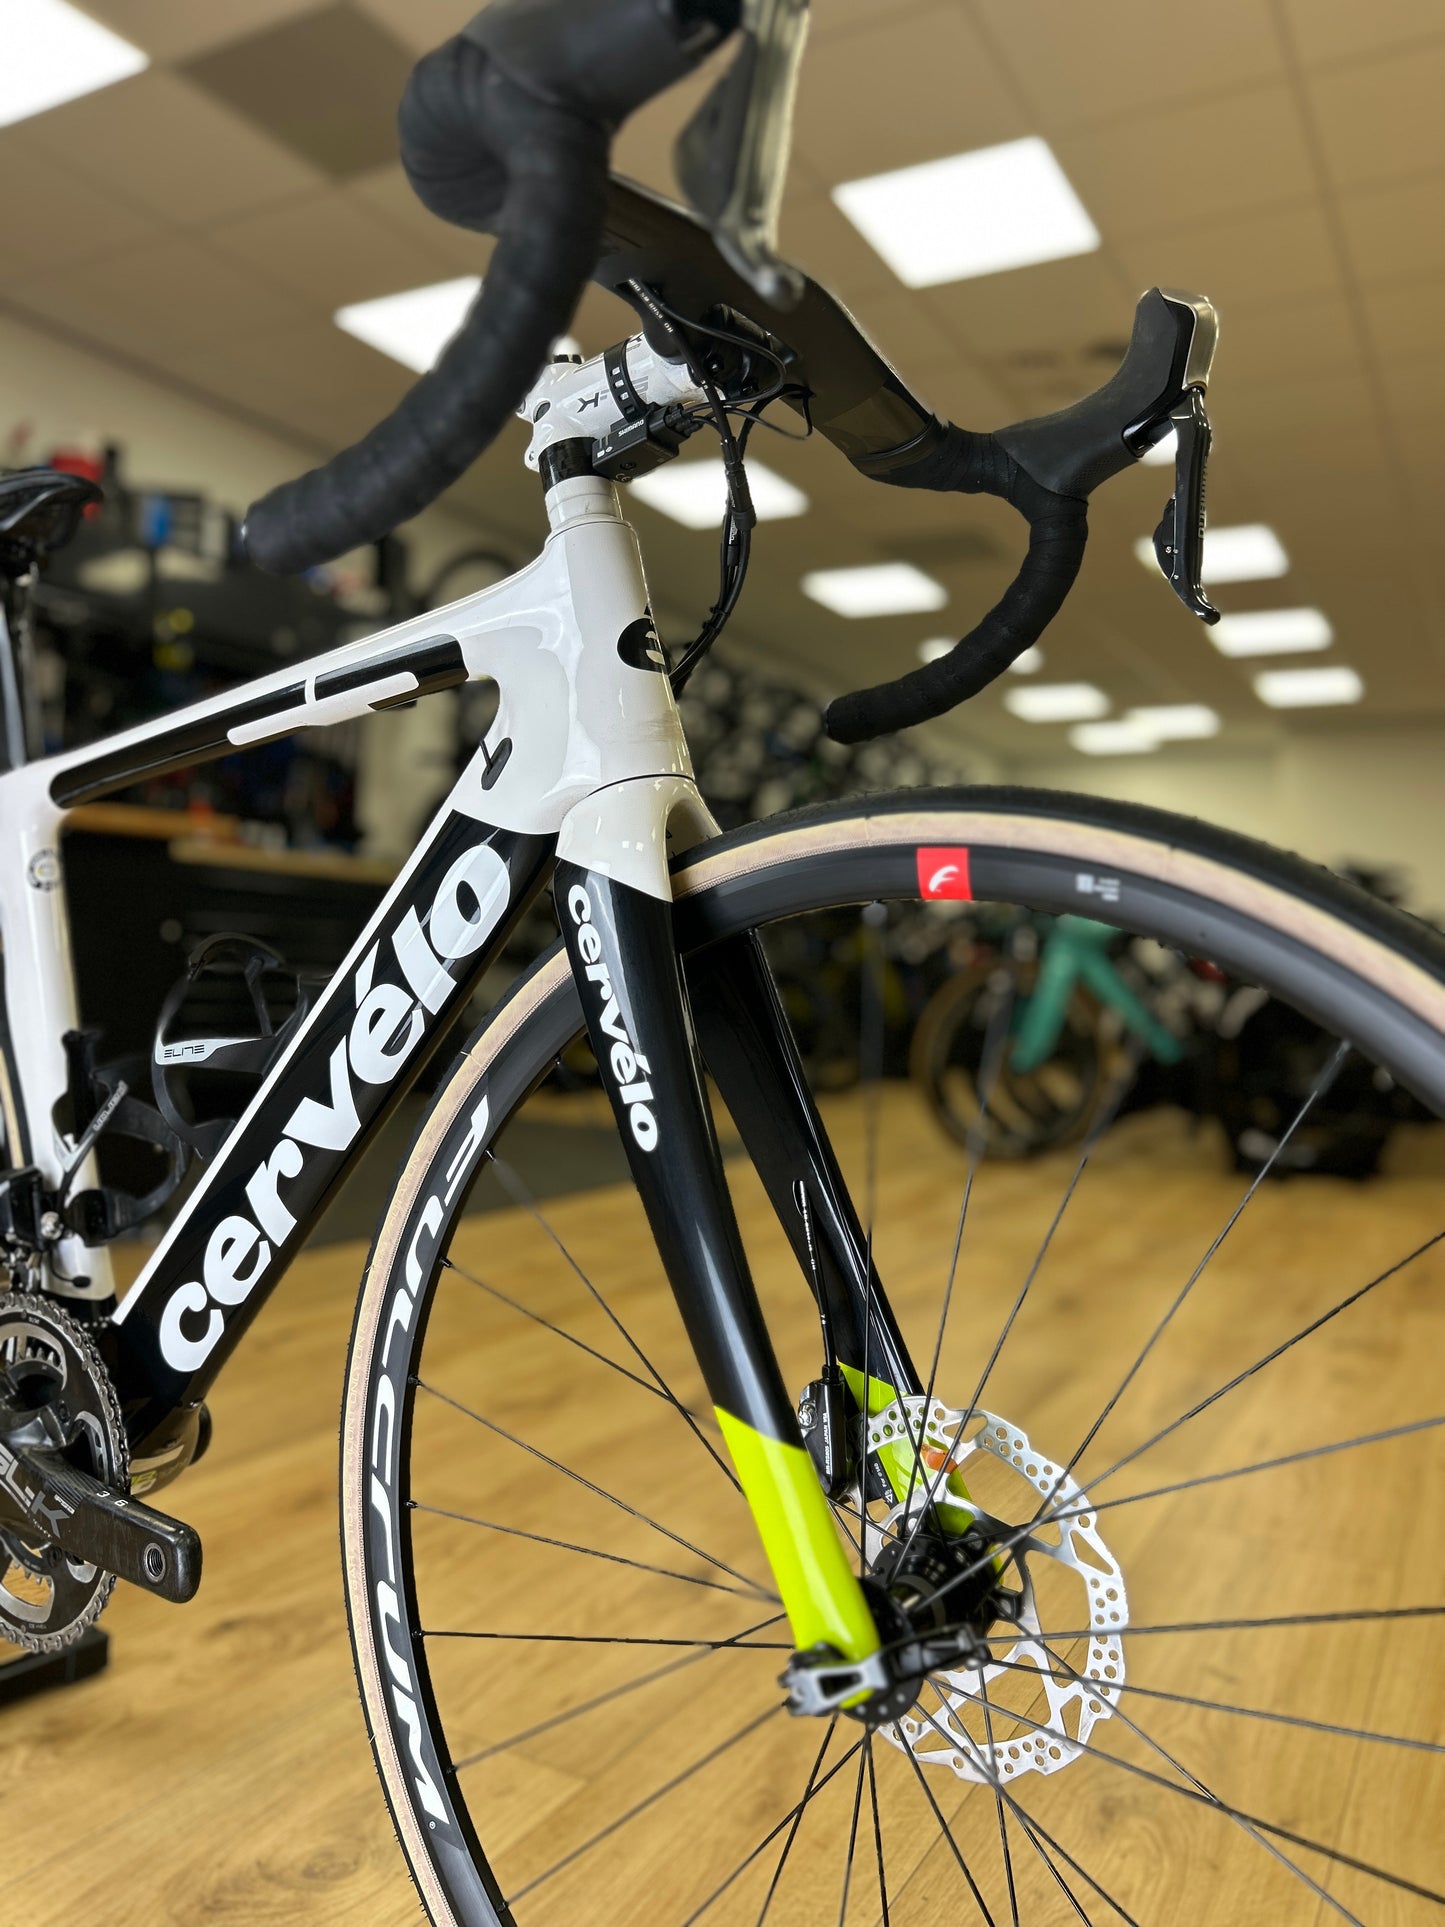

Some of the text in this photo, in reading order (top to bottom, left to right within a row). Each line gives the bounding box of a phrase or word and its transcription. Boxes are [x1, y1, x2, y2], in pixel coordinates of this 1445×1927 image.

[618, 418, 645, 437] SHIMANO
[163, 1044, 205, 1059] ELITE
[568, 884, 658, 1152] cervélo
[159, 844, 511, 1372] cervélo
